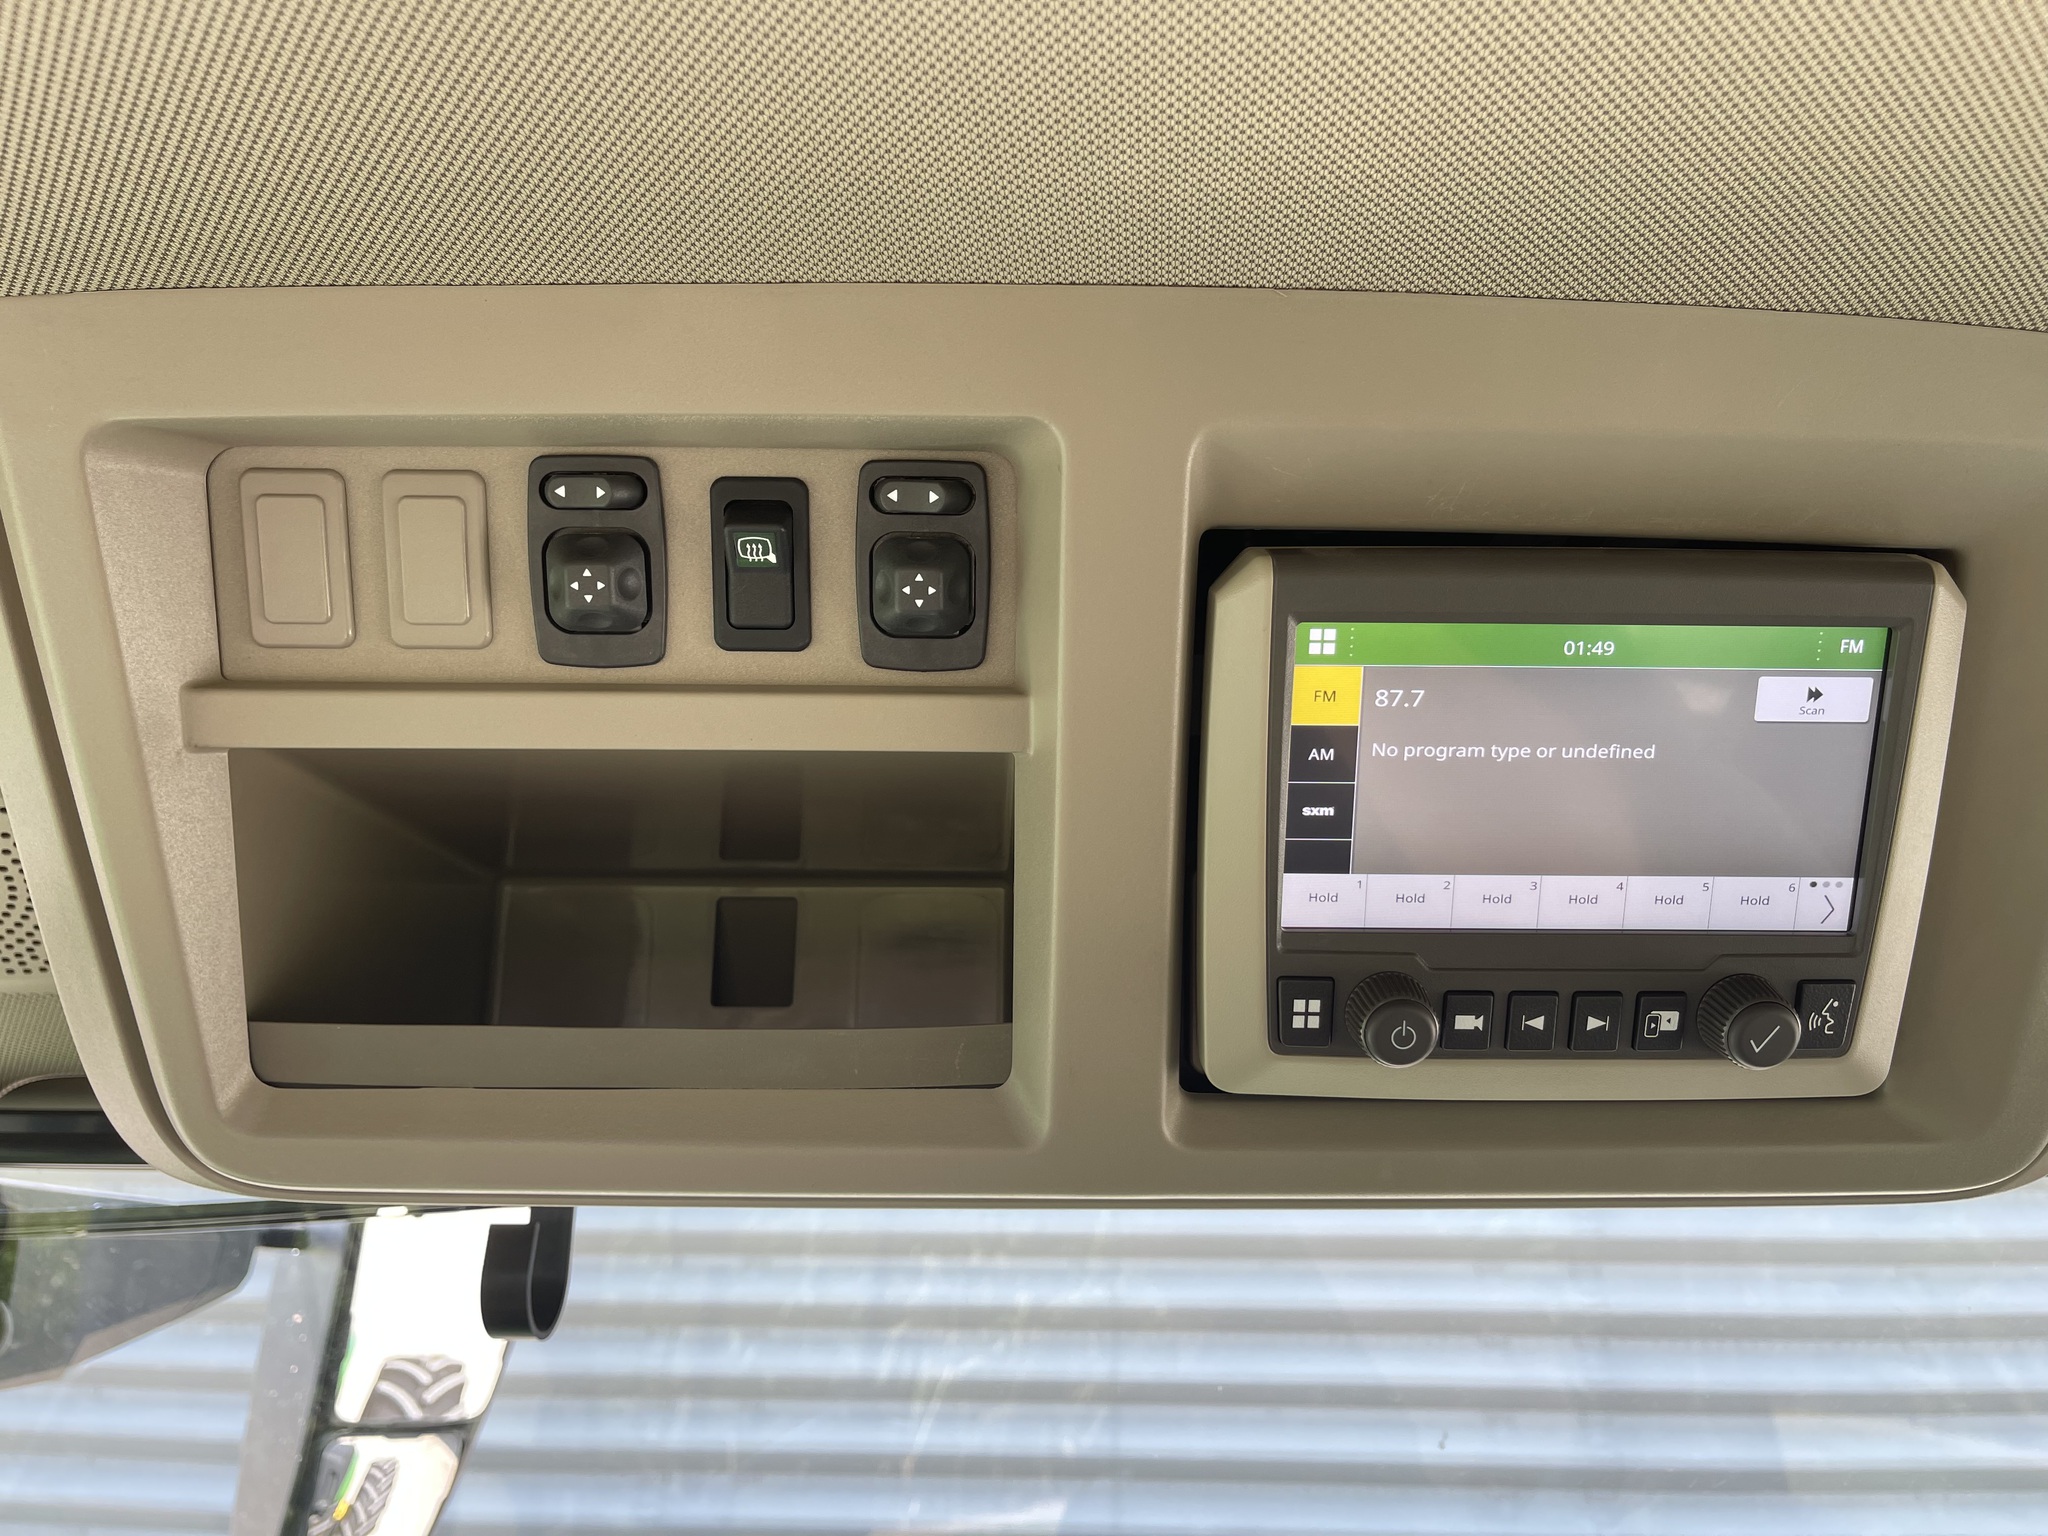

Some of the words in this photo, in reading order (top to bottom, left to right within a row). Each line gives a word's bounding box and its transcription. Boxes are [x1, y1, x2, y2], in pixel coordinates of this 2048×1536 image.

[1564, 640, 1614, 656] 01:49
[1841, 639, 1863, 654] FM
[1315, 690, 1336, 703] FM
[1375, 689, 1424, 708] 87.7
[1799, 705, 1824, 716] Scan
[1308, 748, 1334, 761] AM
[1373, 742, 1398, 757] No
[1404, 745, 1484, 762] program
[1491, 744, 1531, 762] type
[1537, 746, 1557, 759] or
[1562, 743, 1655, 759] undefined
[1302, 806, 1334, 817] sxm
[1443, 881, 1451, 890] 2
[1530, 882, 1537, 890] 3
[1616, 882, 1624, 891] 4
[1702, 883, 1710, 892] 5
[1788, 883, 1796, 892] 6
[1309, 892, 1338, 903] Hold
[1396, 893, 1425, 904] Hold
[1483, 893, 1511, 904] Hold
[1569, 894, 1598, 905] Hold
[1655, 894, 1683, 905] Hold
[1741, 895, 1769, 906] Hold
